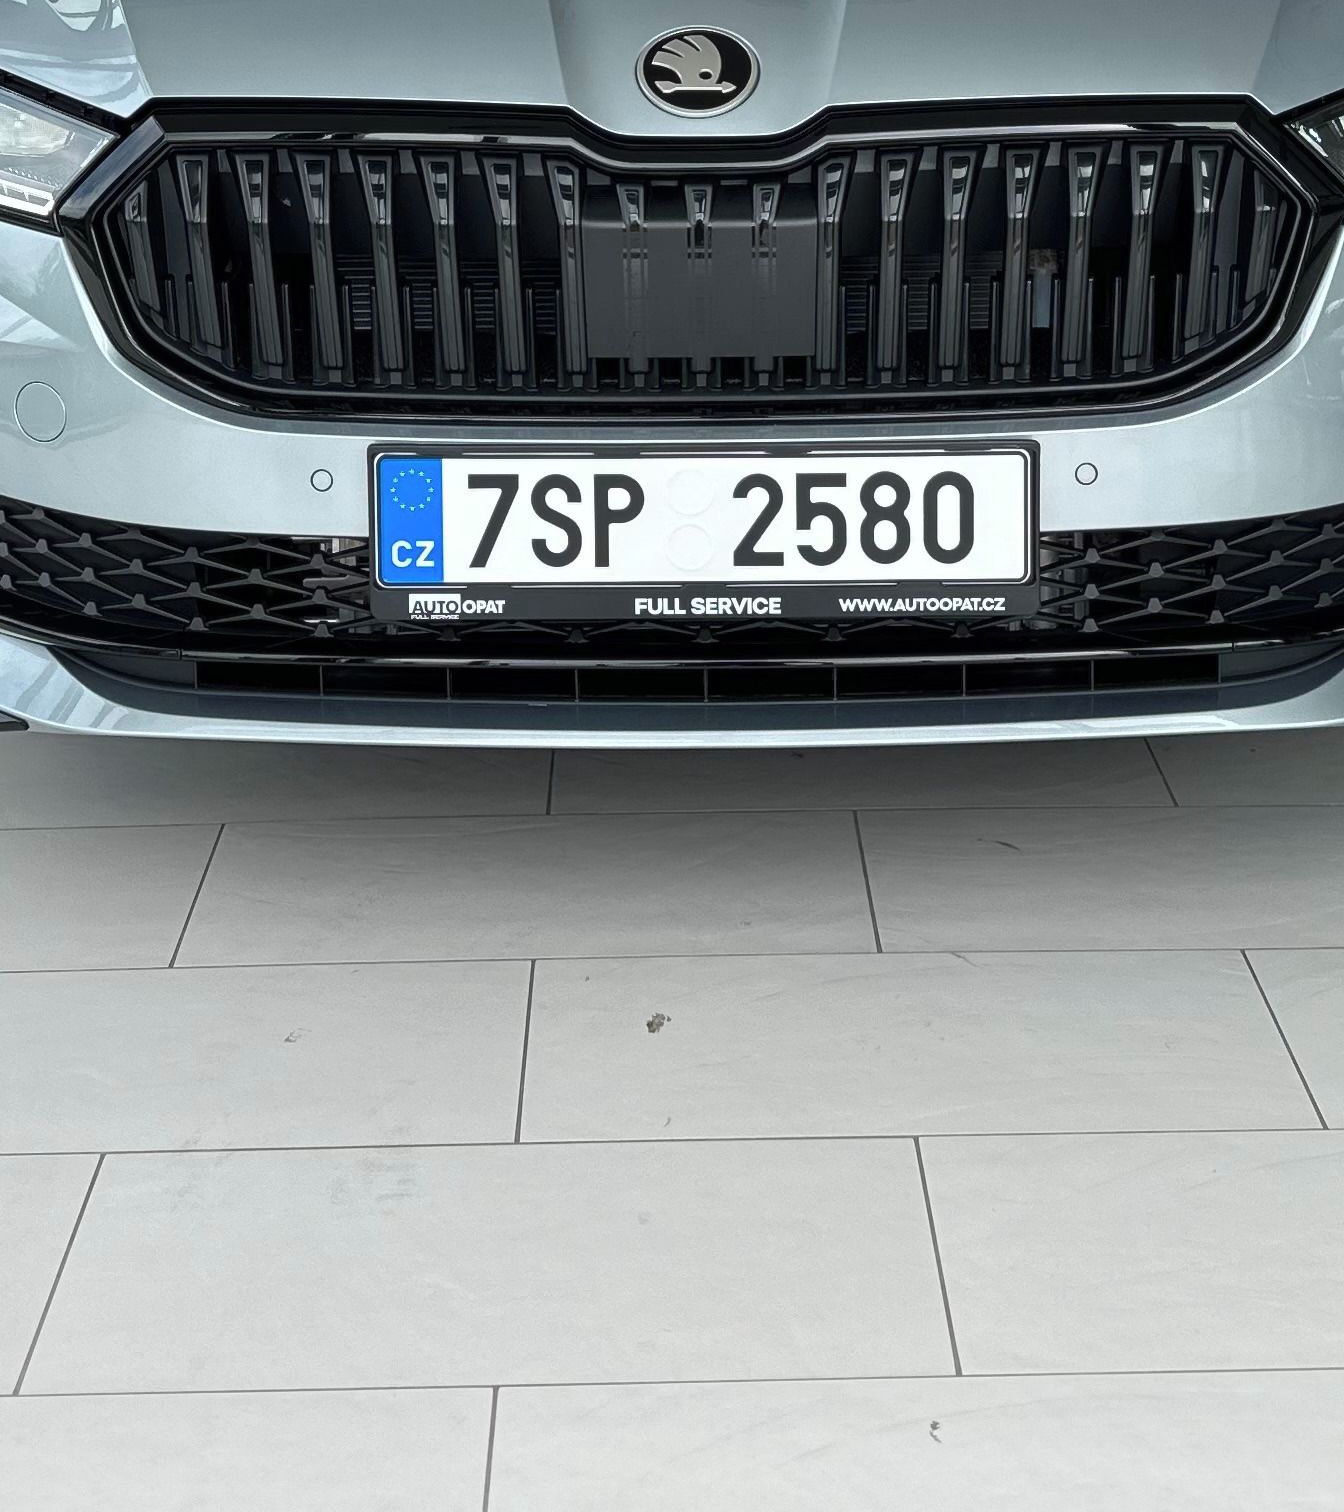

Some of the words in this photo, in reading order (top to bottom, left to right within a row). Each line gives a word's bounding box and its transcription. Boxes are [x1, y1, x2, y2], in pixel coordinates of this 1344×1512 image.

[468, 474, 644, 568] 7SP
[733, 471, 974, 566] 2580
[391, 541, 434, 568] CZ
[635, 598, 685, 614] FULL
[691, 597, 781, 614] SERVICE
[839, 597, 1005, 612] WWW.AUTOOPAT.CZ
